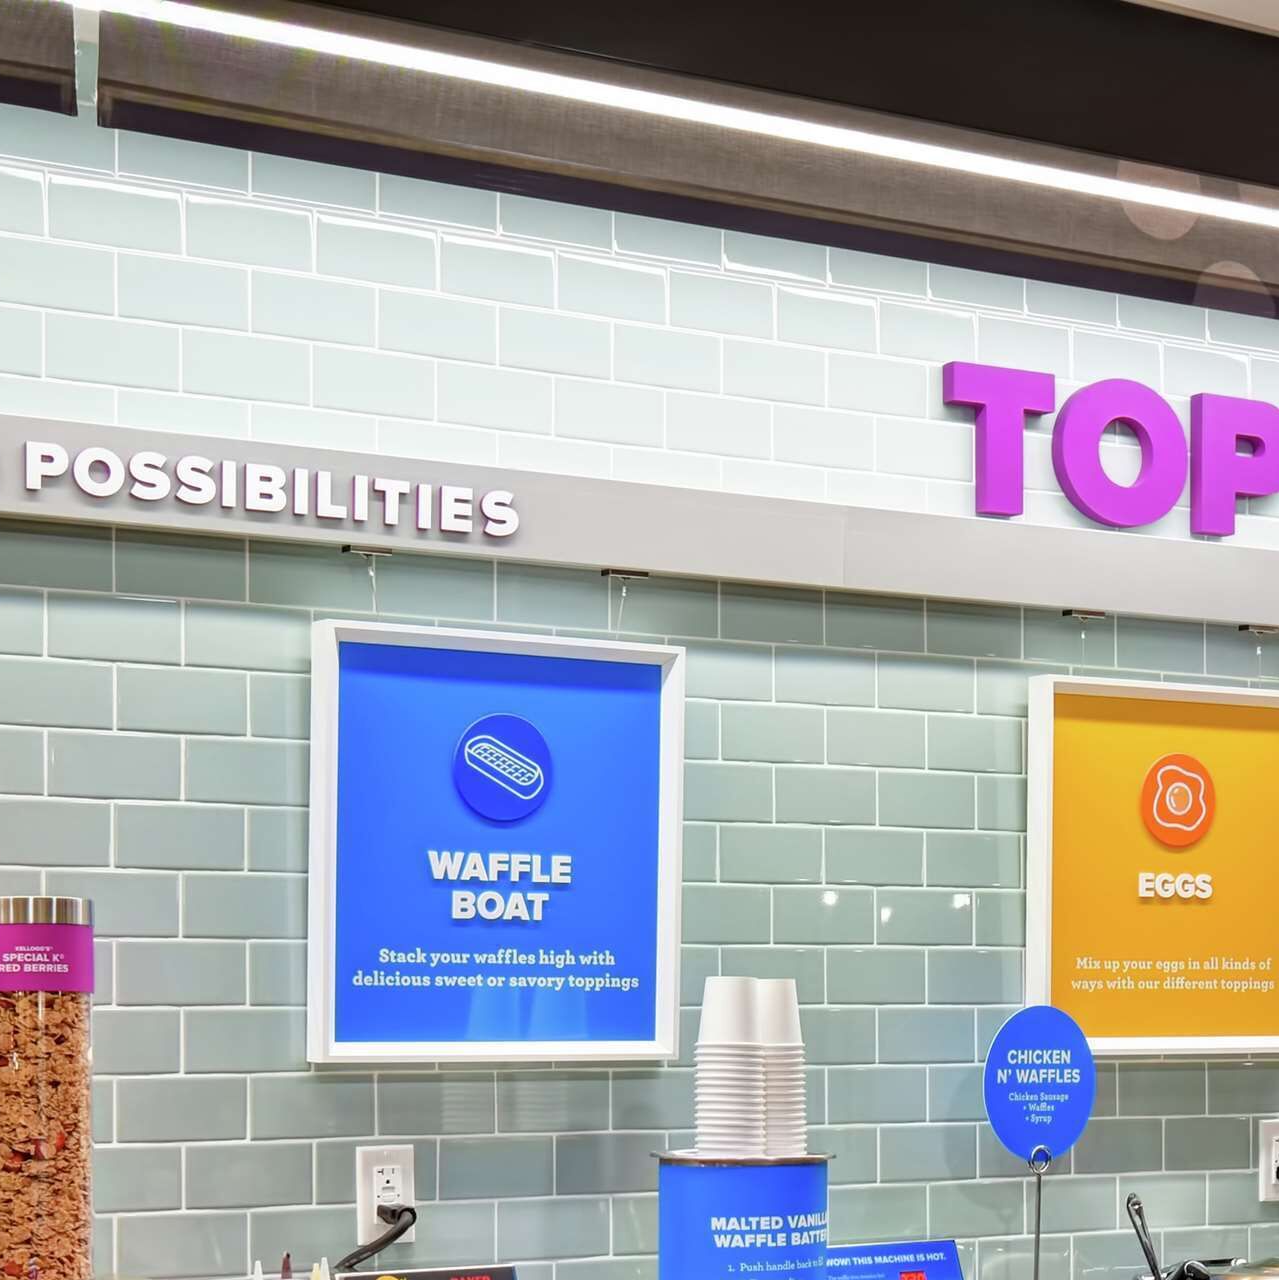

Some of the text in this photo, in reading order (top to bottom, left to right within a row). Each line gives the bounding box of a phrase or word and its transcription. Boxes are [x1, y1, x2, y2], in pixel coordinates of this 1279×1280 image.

[25, 440, 520, 537] POSSIBILITIES
[428, 850, 572, 884] WAFFLE
[1138, 872, 1213, 899] EGGS
[451, 891, 549, 921] BOAT
[2, 953, 49, 962] SPECIAL
[379, 948, 615, 969] Stack your waffles high with
[1076, 957, 1272, 973] Mix up your eggs in all kinds of
[23, 964, 69, 973] BERRIES
[352, 971, 639, 992] delicious sweet or savory toppings
[1071, 976, 1274, 993] ways with our different toppings
[1007, 1049, 1071, 1064] CHICKEN
[1016, 1069, 1080, 1083] WAFFLES
[1009, 1092, 1069, 1102] Chicken Sausage
[1028, 1103, 1055, 1111] Waffles
[1030, 1114, 1052, 1124] Syrup
[711, 1216, 783, 1231] MALTED
[714, 1233, 787, 1248] WAFFLE
[740, 1263, 763, 1272] Push
[766, 1260, 795, 1271] handle
[796, 1259, 811, 1269] back
[852, 1256, 872, 1265] THIS
[874, 1254, 915, 1264] MACHINE
[916, 1253, 925, 1262] IS
[926, 1252, 946, 1261] HOT.
